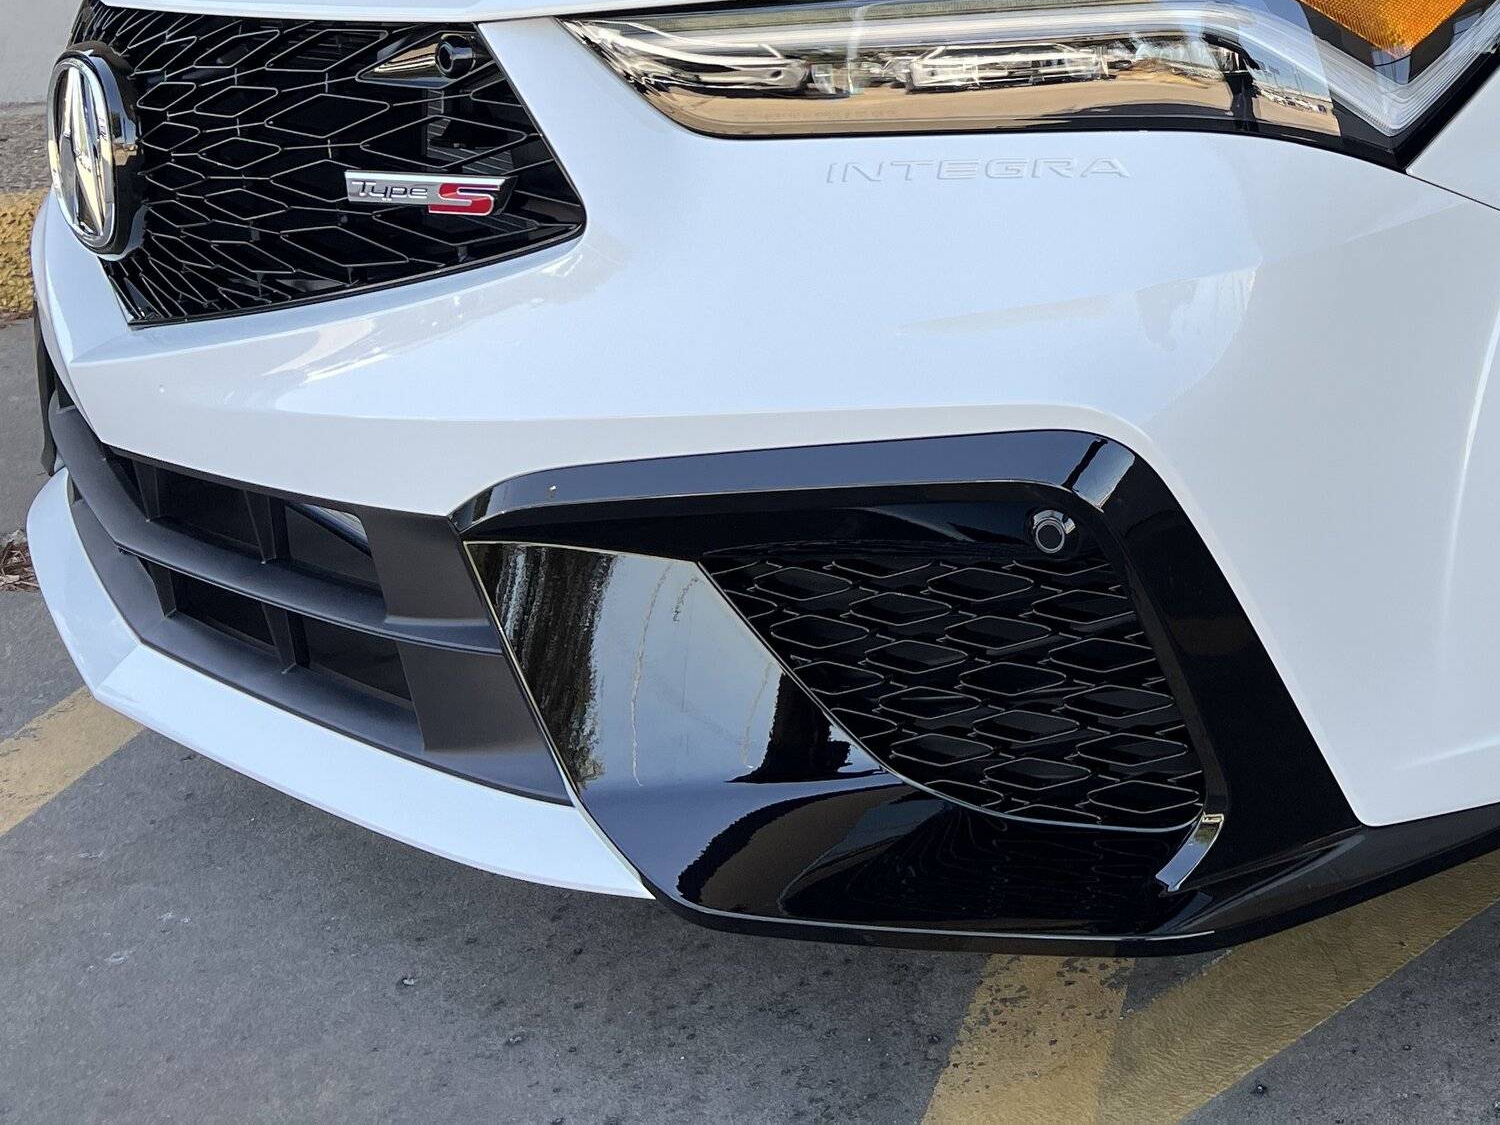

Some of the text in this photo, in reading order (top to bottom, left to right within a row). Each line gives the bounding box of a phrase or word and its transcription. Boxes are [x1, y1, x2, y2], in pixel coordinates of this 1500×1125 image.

[826, 155, 1130, 184] INTEGRA
[352, 181, 501, 217] Type S
